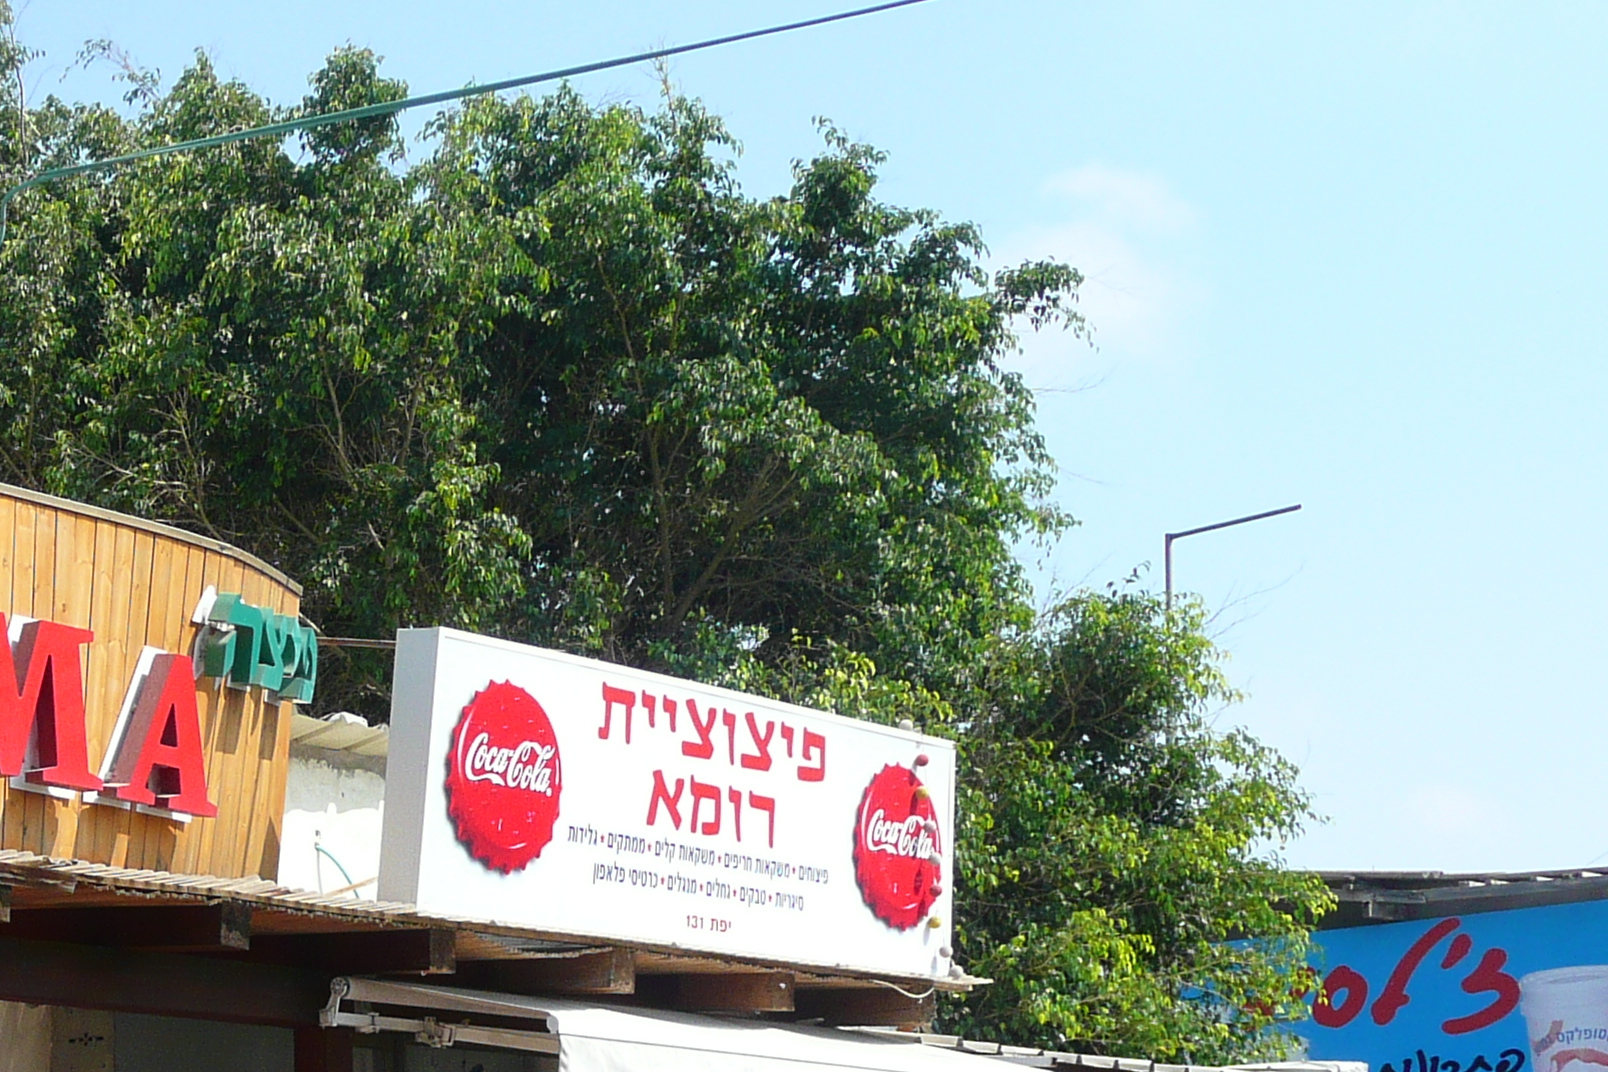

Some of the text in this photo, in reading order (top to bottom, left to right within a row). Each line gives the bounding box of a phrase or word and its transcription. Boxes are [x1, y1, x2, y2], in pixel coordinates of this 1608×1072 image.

[598, 681, 826, 782] פיצוציית
[465, 732, 557, 796] Coca-Cola
[646, 769, 776, 849] רומא
[567, 823, 598, 846] גלידות
[607, 832, 646, 855] ממתקים
[654, 837, 676, 863] קלים
[678, 843, 715, 867] משקאות
[592, 860, 626, 885] פלאפון
[723, 852, 753, 873] חריפים
[628, 868, 659, 889] כרטיסי
[706, 877, 731, 900] גחלים
[739, 886, 767, 907] טבקים
[685, 914, 732, 933] יפת 131
